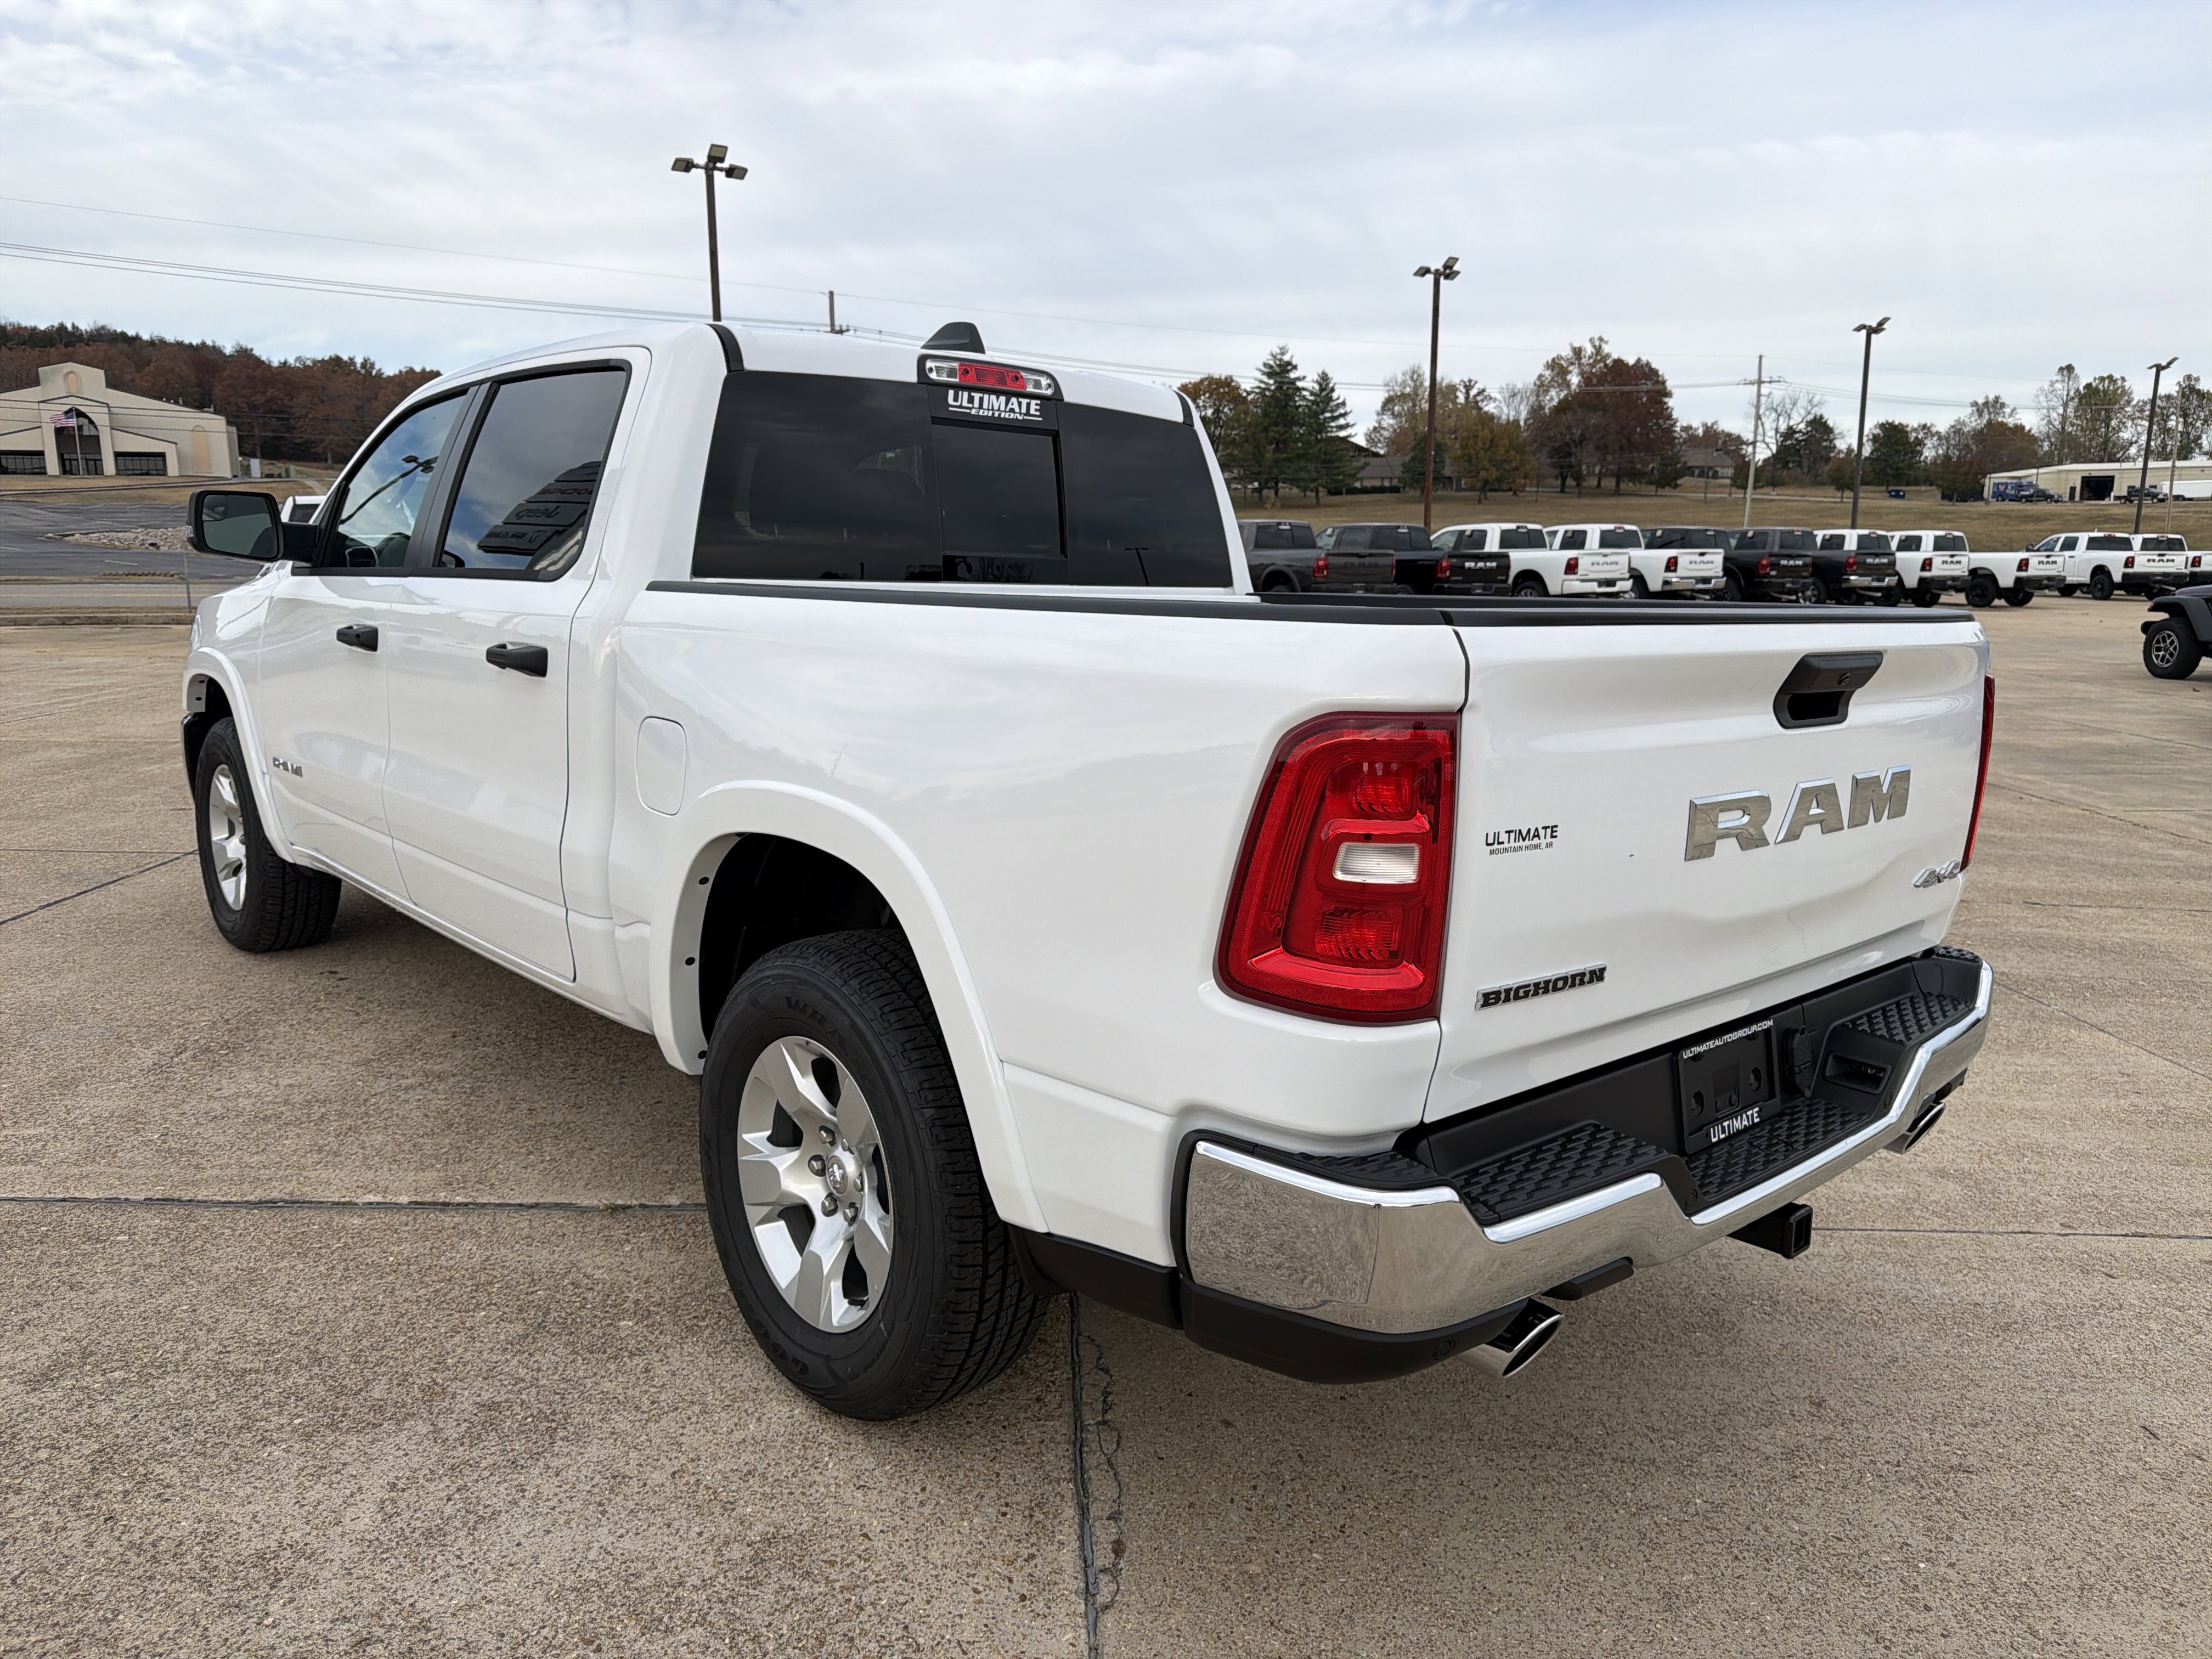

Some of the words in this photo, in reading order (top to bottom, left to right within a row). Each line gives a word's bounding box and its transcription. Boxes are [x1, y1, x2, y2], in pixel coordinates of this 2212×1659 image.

[948, 390, 1041, 415] ULTIMATE
[970, 409, 1024, 420] EDITION
[1464, 561, 1497, 569] RAM
[1684, 764, 1911, 861] RAM
[1486, 825, 1558, 846] ULTIMATE
[1489, 845, 1523, 856] MOUNTAIN
[1525, 843, 1544, 852] HOME,
[1475, 963, 1607, 1010] BIGHORN
[1683, 1019, 1773, 1059] ULTIMATEAUTOGROUP.COM
[1710, 1107, 1760, 1143] ULTIMATE
